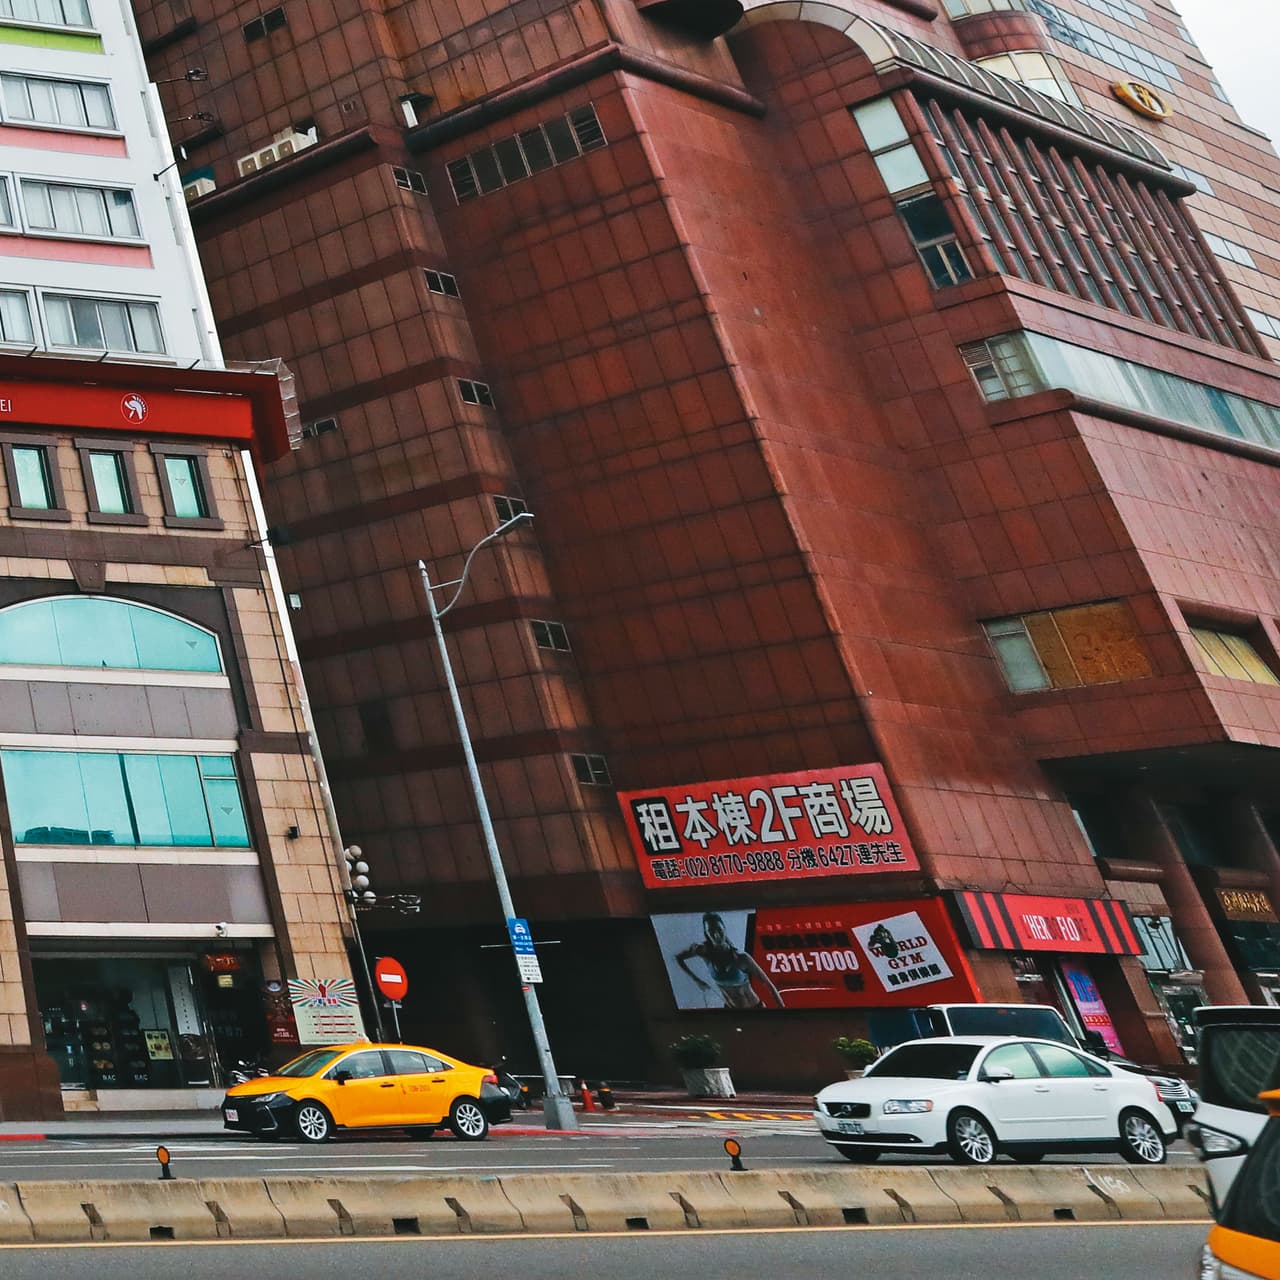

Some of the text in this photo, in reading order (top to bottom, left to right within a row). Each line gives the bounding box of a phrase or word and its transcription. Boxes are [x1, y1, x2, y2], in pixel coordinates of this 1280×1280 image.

[635, 776, 893, 853] 租本棟2F商場
[766, 950, 859, 973] 2311-7000
[888, 951, 926, 970] GYM
